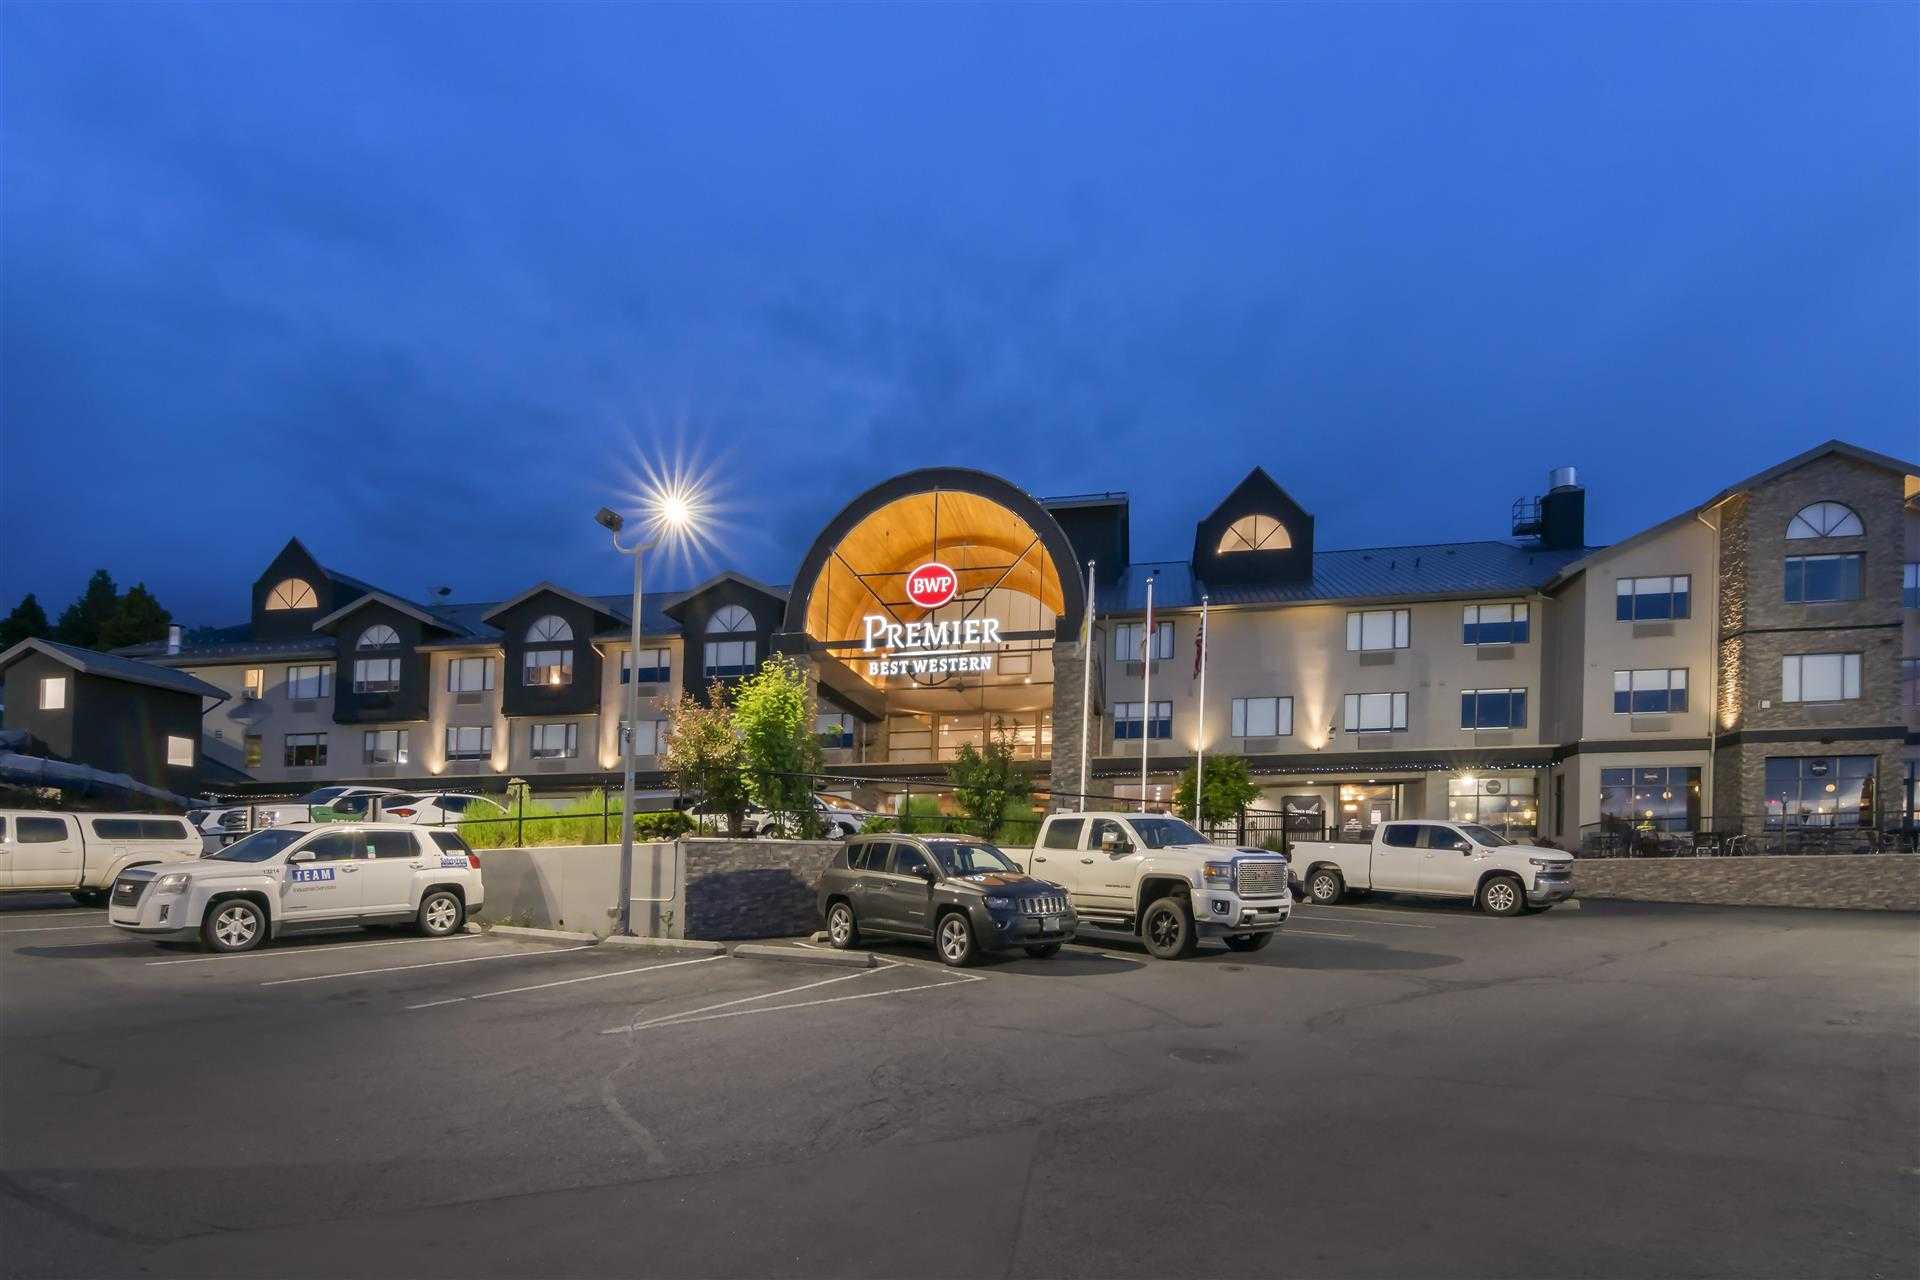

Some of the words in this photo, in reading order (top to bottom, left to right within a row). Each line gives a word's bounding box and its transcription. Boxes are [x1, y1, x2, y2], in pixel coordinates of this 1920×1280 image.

[913, 576, 952, 594] BWP
[862, 615, 1002, 653] PREMIER
[869, 660, 909, 676] BEST
[912, 656, 992, 675] WESTERN
[295, 868, 331, 881] TEAM
